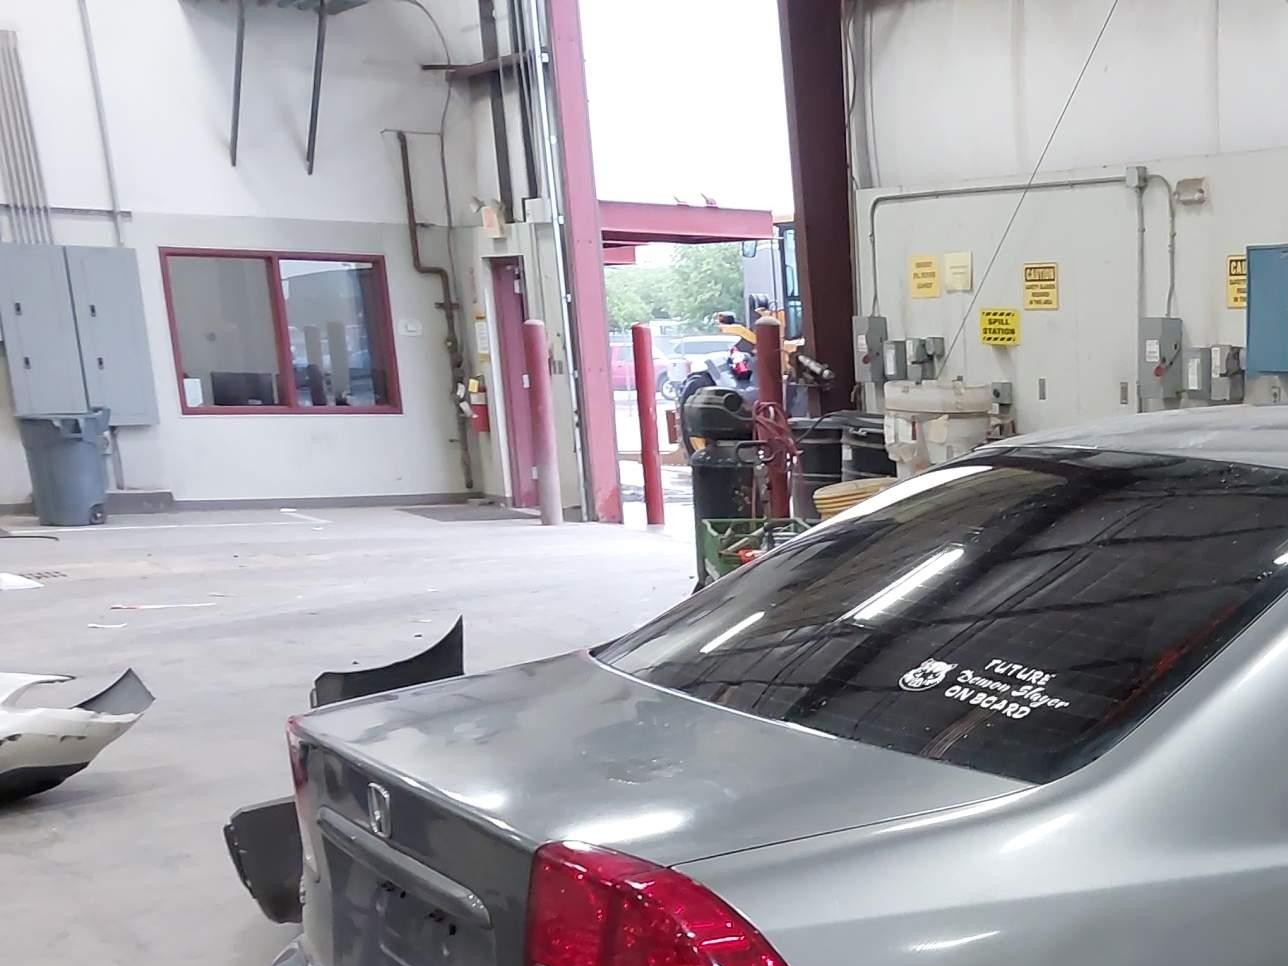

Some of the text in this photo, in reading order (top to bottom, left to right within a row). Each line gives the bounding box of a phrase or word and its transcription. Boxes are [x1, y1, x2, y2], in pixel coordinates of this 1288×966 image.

[982, 327, 1015, 335] STATION
[988, 318, 1010, 326] SPILL
[984, 659, 1056, 686] FUTURE
[944, 685, 1031, 720] ON BOARD
[956, 670, 1070, 709] Demon Slayer
